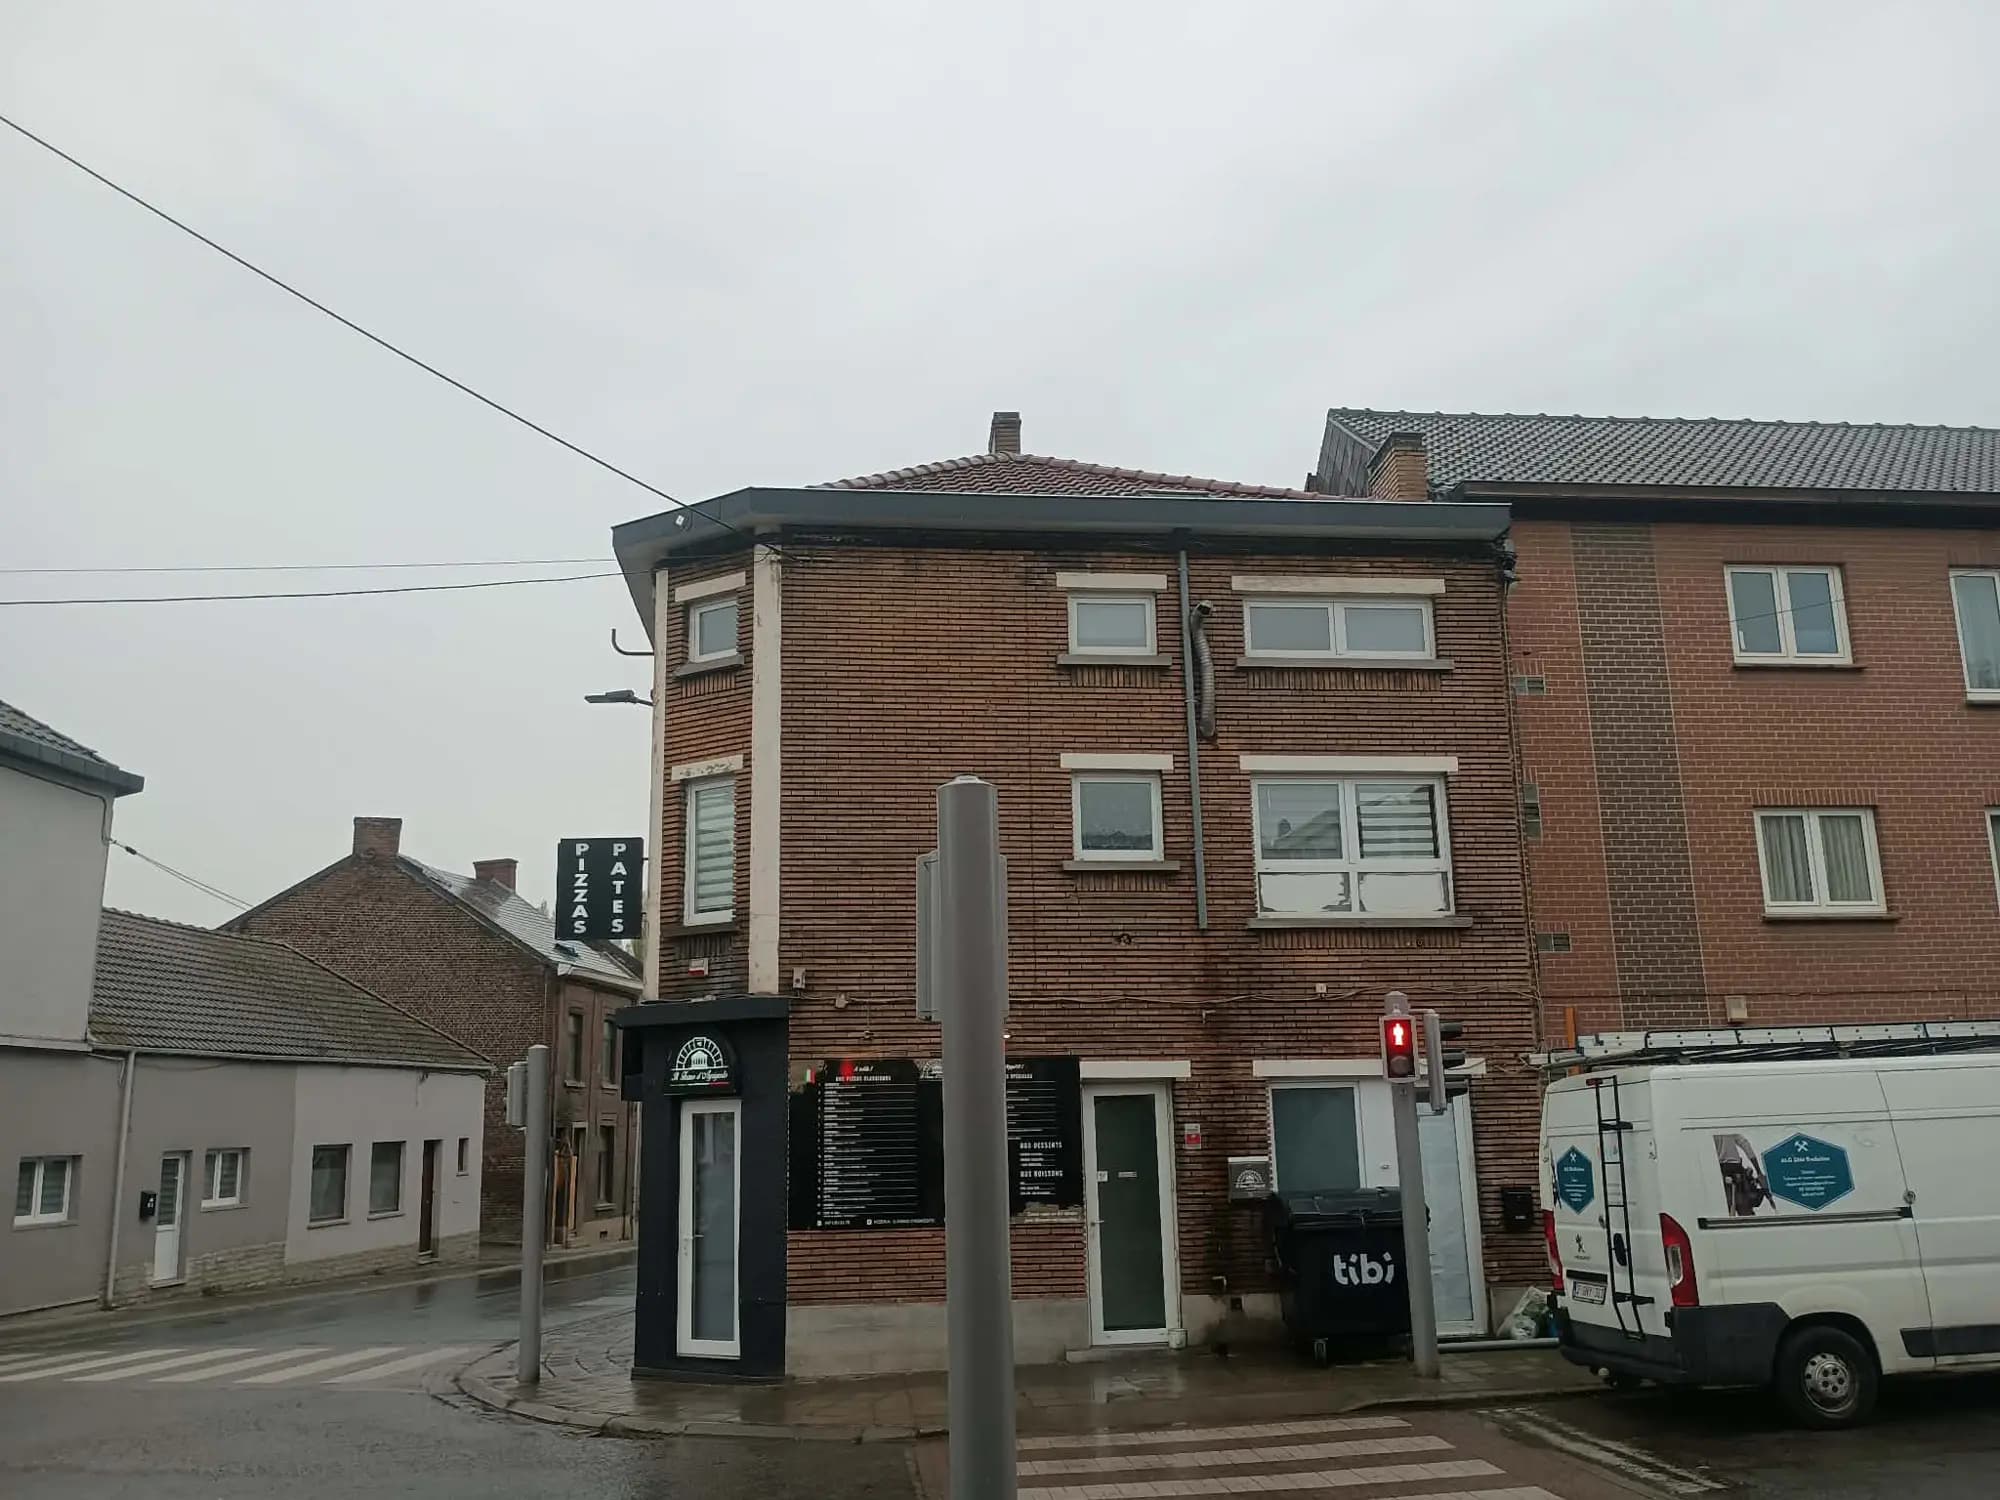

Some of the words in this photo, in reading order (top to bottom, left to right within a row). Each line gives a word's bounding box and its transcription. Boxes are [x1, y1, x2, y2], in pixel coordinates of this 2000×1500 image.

[571, 843, 590, 933] PIZZAS
[610, 843, 627, 932] PATES
[1033, 1141, 1063, 1149] DESSERTS
[1333, 1251, 1395, 1285] tibi
